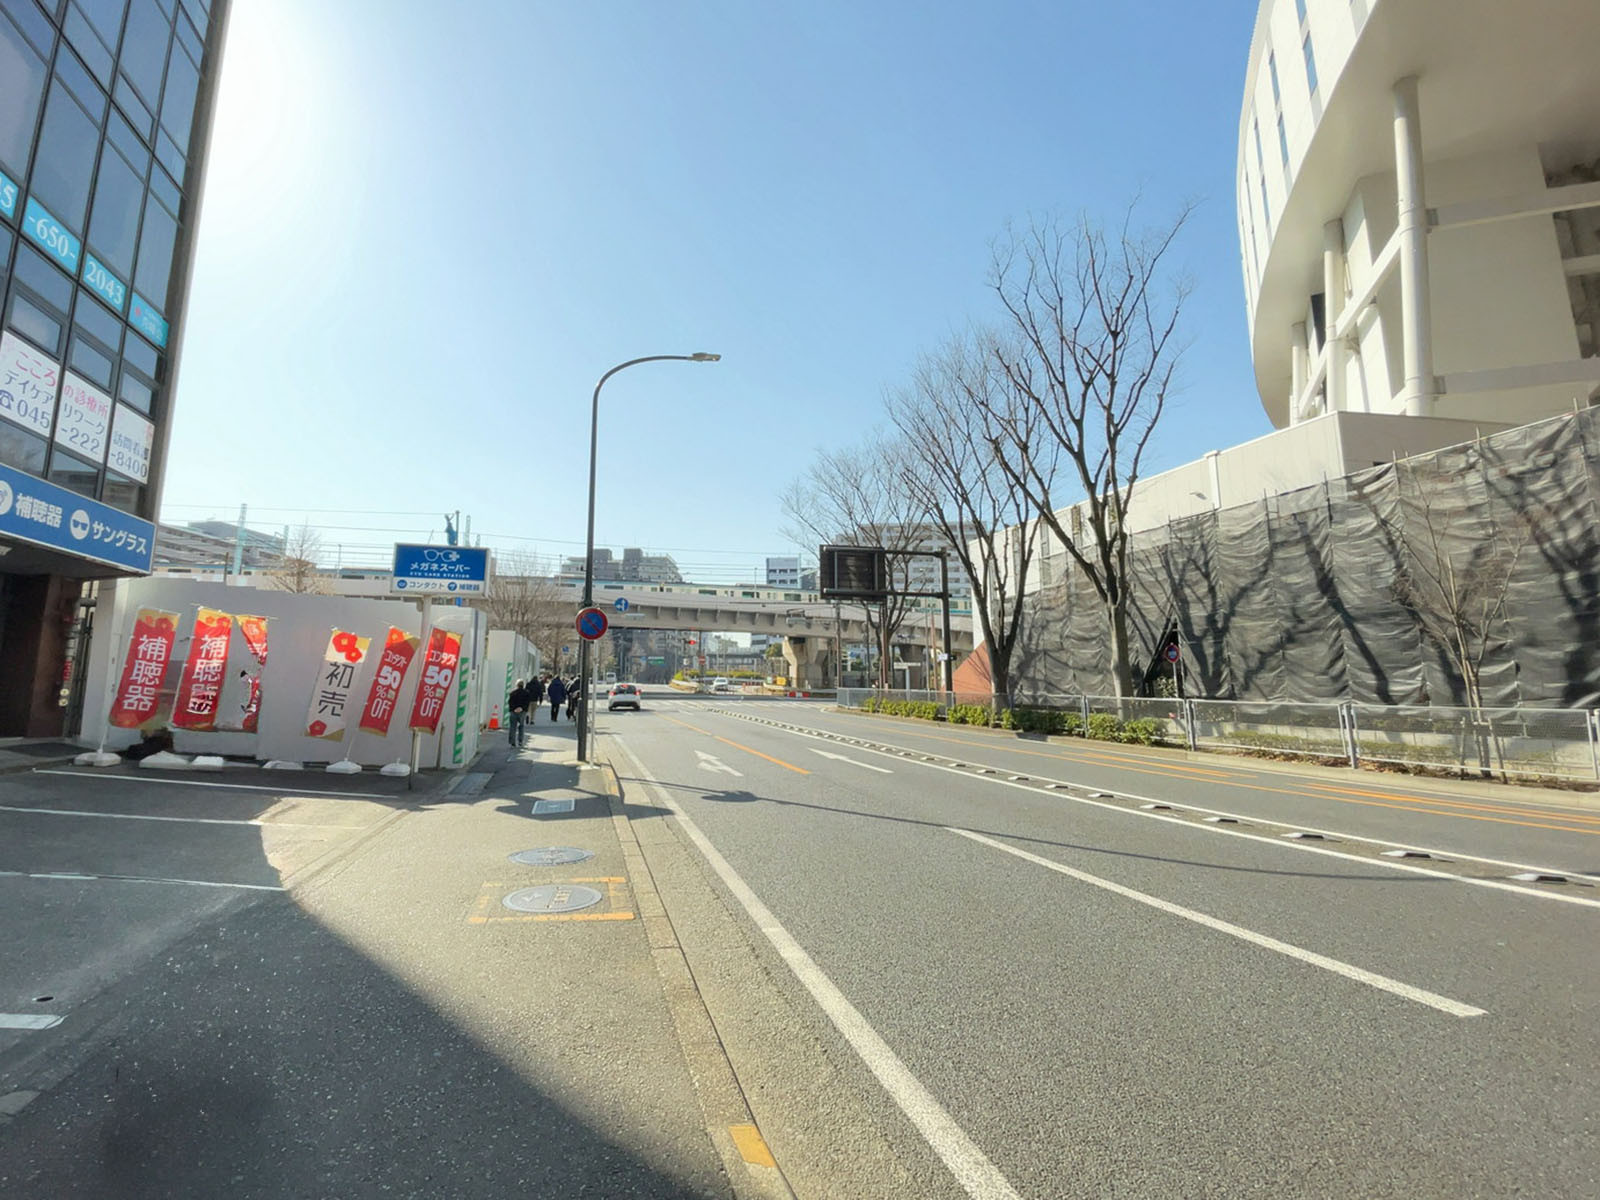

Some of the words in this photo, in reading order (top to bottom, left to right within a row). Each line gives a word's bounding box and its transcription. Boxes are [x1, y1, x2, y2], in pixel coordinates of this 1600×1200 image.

[86, 261, 123, 305] 2043
[15, 351, 57, 387] こころ
[16, 399, 51, 429] 045
[63, 402, 105, 435] リワーク
[15, 493, 63, 529] 補聴器
[92, 520, 147, 556] サングラス
[410, 562, 470, 572] メガネスーパー
[409, 581, 445, 590] コンタクト
[123, 635, 168, 712] 補聴器
[318, 661, 354, 716] 初売
[377, 664, 402, 689] 50
[424, 664, 453, 689] 50
